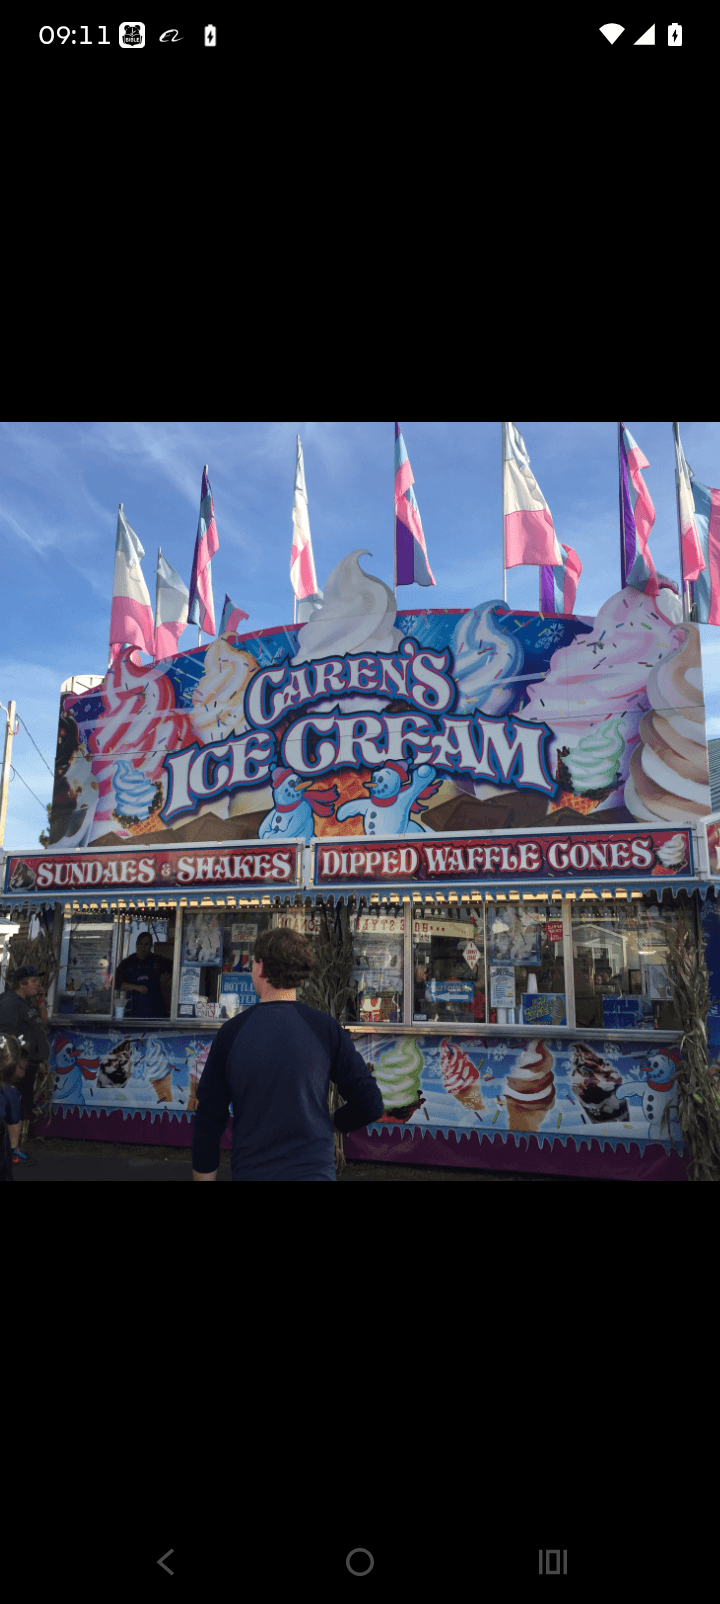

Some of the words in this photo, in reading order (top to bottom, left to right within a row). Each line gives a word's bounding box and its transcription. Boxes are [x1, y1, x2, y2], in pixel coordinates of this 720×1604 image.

[248, 641, 453, 726] CAREN'S
[164, 736, 272, 815] ICE
[285, 713, 555, 793] CREAM
[37, 858, 156, 887] SUNDAES
[161, 864, 171, 877] &
[177, 851, 291, 882] SHAKES
[321, 848, 418, 876] DIPPED
[424, 843, 539, 873] WAFFLE
[548, 839, 653, 869] CONES
[196, 1001, 216, 1009] CASH
[224, 982, 255, 992] BOTTLE
[197, 1010, 216, 1018] ONLY
